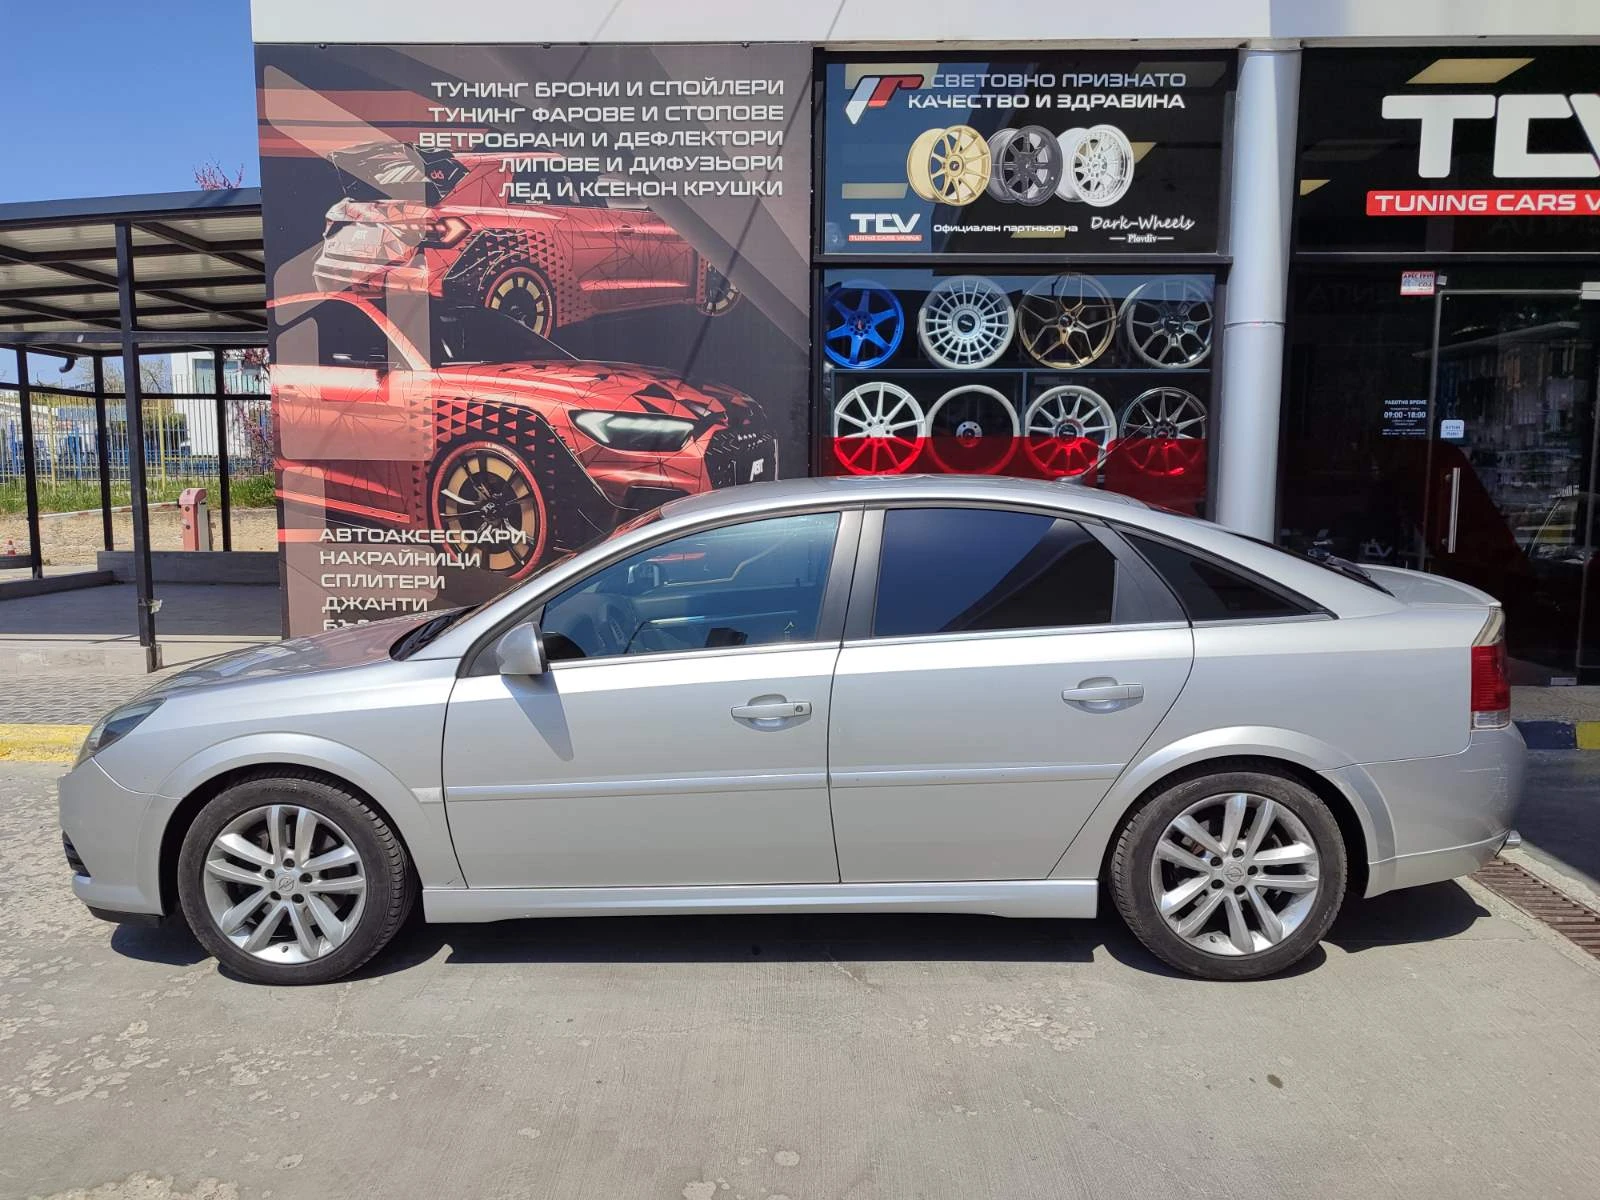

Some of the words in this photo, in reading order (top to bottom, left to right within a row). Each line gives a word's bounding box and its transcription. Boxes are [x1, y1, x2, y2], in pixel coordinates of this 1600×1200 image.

[431, 81, 528, 98] ТУНИНГ
[535, 81, 619, 97] БРОНИ
[626, 81, 642, 96] И
[650, 77, 784, 96] СПОЙЛЕРИ
[931, 73, 1055, 88] СВЕТОВНО
[1062, 72, 1186, 87] ПРИЗНАТО
[908, 94, 1029, 109] КАЧЕСТВО
[1035, 94, 1050, 108] И
[1057, 94, 1185, 111] ЗДРАВИНА
[428, 107, 525, 123] ТУНИНГ
[532, 106, 634, 122] ФАРОВЕ
[642, 106, 658, 121] И
[665, 106, 784, 121] СТОПОВЕ
[419, 132, 584, 148] ВЕТРОБРАНИ
[592, 131, 607, 147] И
[615, 130, 783, 150] ДЕФЛЕКТОРИ
[1381, 93, 1600, 178] TC
[498, 156, 599, 172] ЛИПОВЕ
[607, 156, 622, 172] И
[629, 155, 783, 175] ДИФУЗЬОРИ
[498, 182, 550, 200] ЛЕД
[557, 182, 572, 197] И
[580, 182, 677, 197] КСЕНОН
[684, 181, 783, 196] КРУШКИ
[1374, 194, 1487, 211] TUNING
[1496, 194, 1576, 211] CARS
[850, 213, 921, 233] TCV
[933, 224, 1001, 234] Официален
[1003, 224, 1061, 234] партньор
[1091, 215, 1196, 231] Dark-Wheels
[1127, 233, 1158, 243] Plovdiv
[319, 528, 526, 545] АВТОАКСЕСОАРИ
[319, 549, 480, 570] НАКРАЙНИЦИ
[321, 573, 445, 590] СПЛИТЕРИ
[321, 596, 428, 614] ДЖАНТИ
